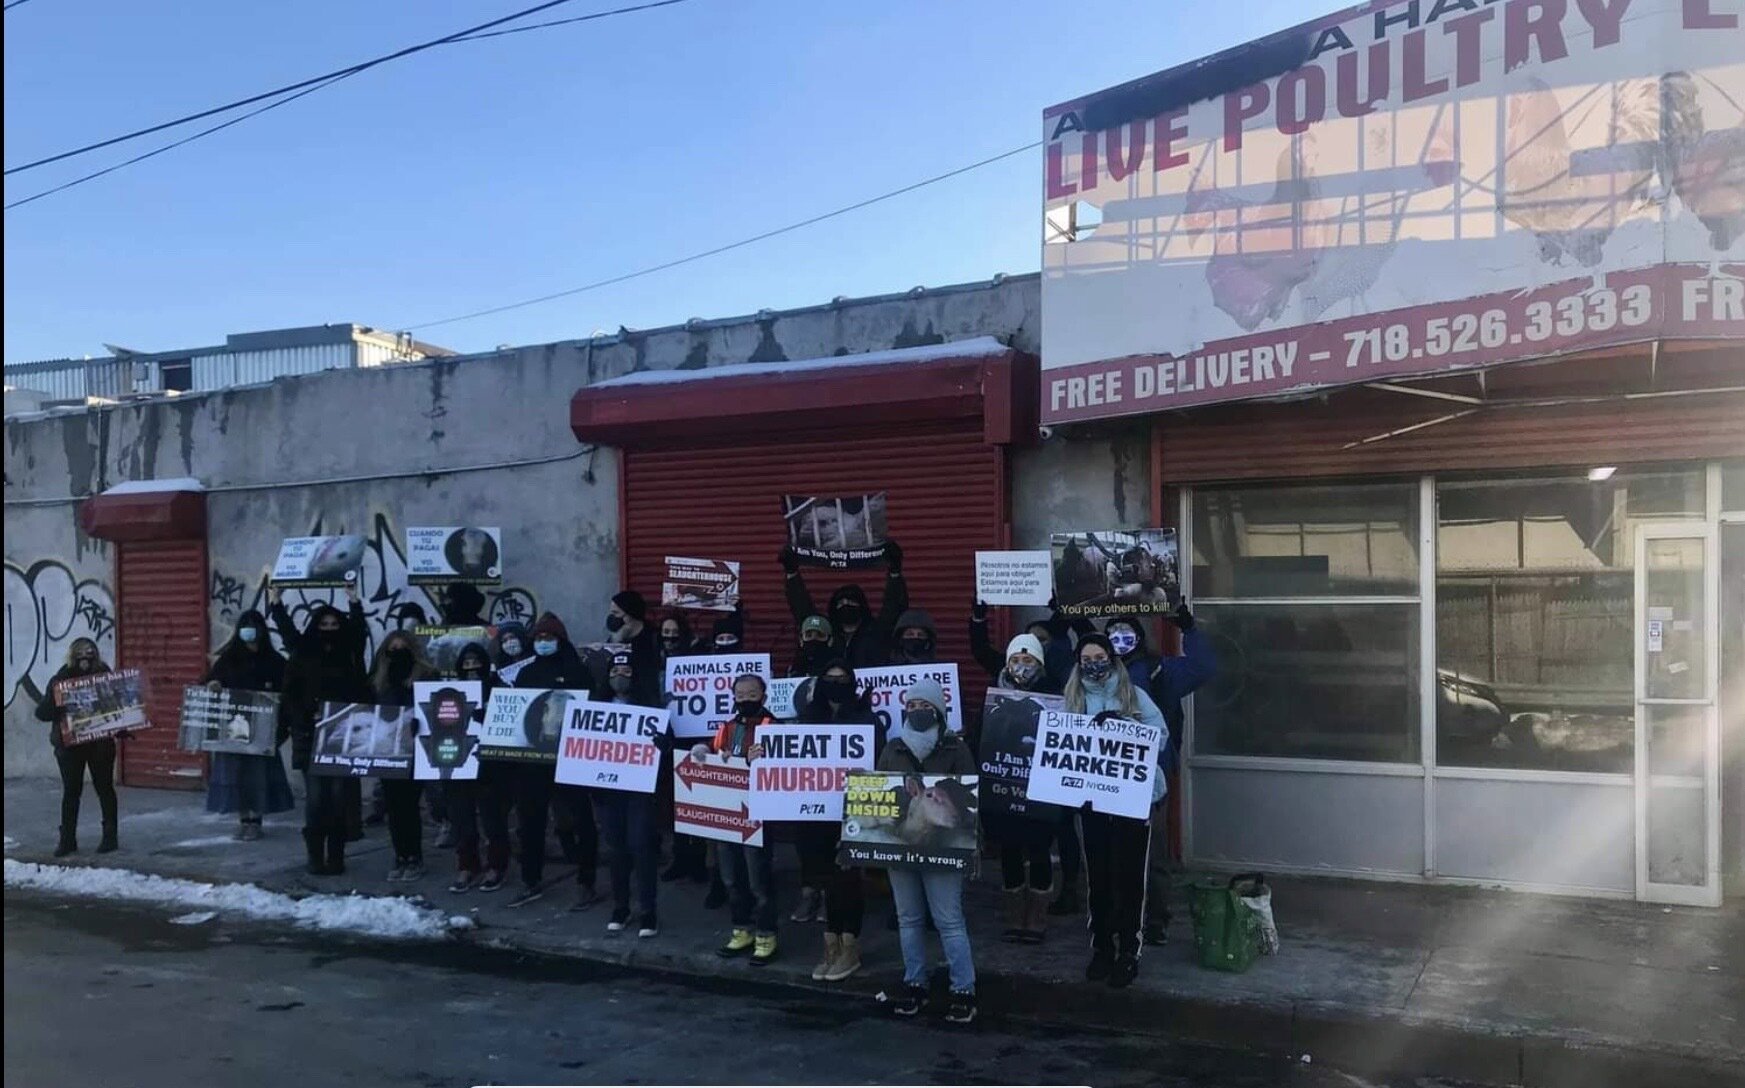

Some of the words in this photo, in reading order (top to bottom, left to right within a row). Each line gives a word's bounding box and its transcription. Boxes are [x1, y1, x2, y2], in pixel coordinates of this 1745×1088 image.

[1047, 104, 1190, 201] LIVE
[1223, 0, 1633, 154] POULTRY
[1051, 370, 1122, 412] FREE
[1134, 341, 1299, 399] DELIVERY
[1343, 284, 1652, 368] 718.526.3333
[1060, 605, 1081, 614] You
[1083, 605, 1102, 616] pay
[1104, 603, 1137, 613] others
[1139, 603, 1150, 612] to
[673, 663, 732, 675] ANIMALS
[736, 662, 763, 673] ARE
[673, 677, 708, 692] NOT
[855, 674, 917, 688] ANIMALS
[494, 695, 528, 703] WHEN
[674, 695, 707, 716] TO
[497, 705, 518, 713] YOU
[493, 714, 517, 723] BUY
[571, 709, 632, 735] MEAT
[637, 715, 660, 737] IS
[564, 737, 656, 766] MURDER
[761, 735, 831, 758] MEAT
[840, 734, 864, 758] IS
[1045, 731, 1092, 753] BAN
[1098, 737, 1150, 762] WET
[995, 751, 1000, 761] I
[1002, 753, 1023, 765] Am
[981, 762, 1010, 777] Only
[1040, 751, 1148, 783] MARKETS
[757, 767, 864, 791] MURDE
[848, 775, 888, 787] DEEP
[847, 791, 897, 803] DOWN
[992, 783, 1008, 796] Go
[846, 804, 900, 817] INSIDE
[849, 849, 870, 860] You
[873, 850, 902, 862] know
[907, 852, 924, 863] it's
[928, 856, 967, 869] wrong.
